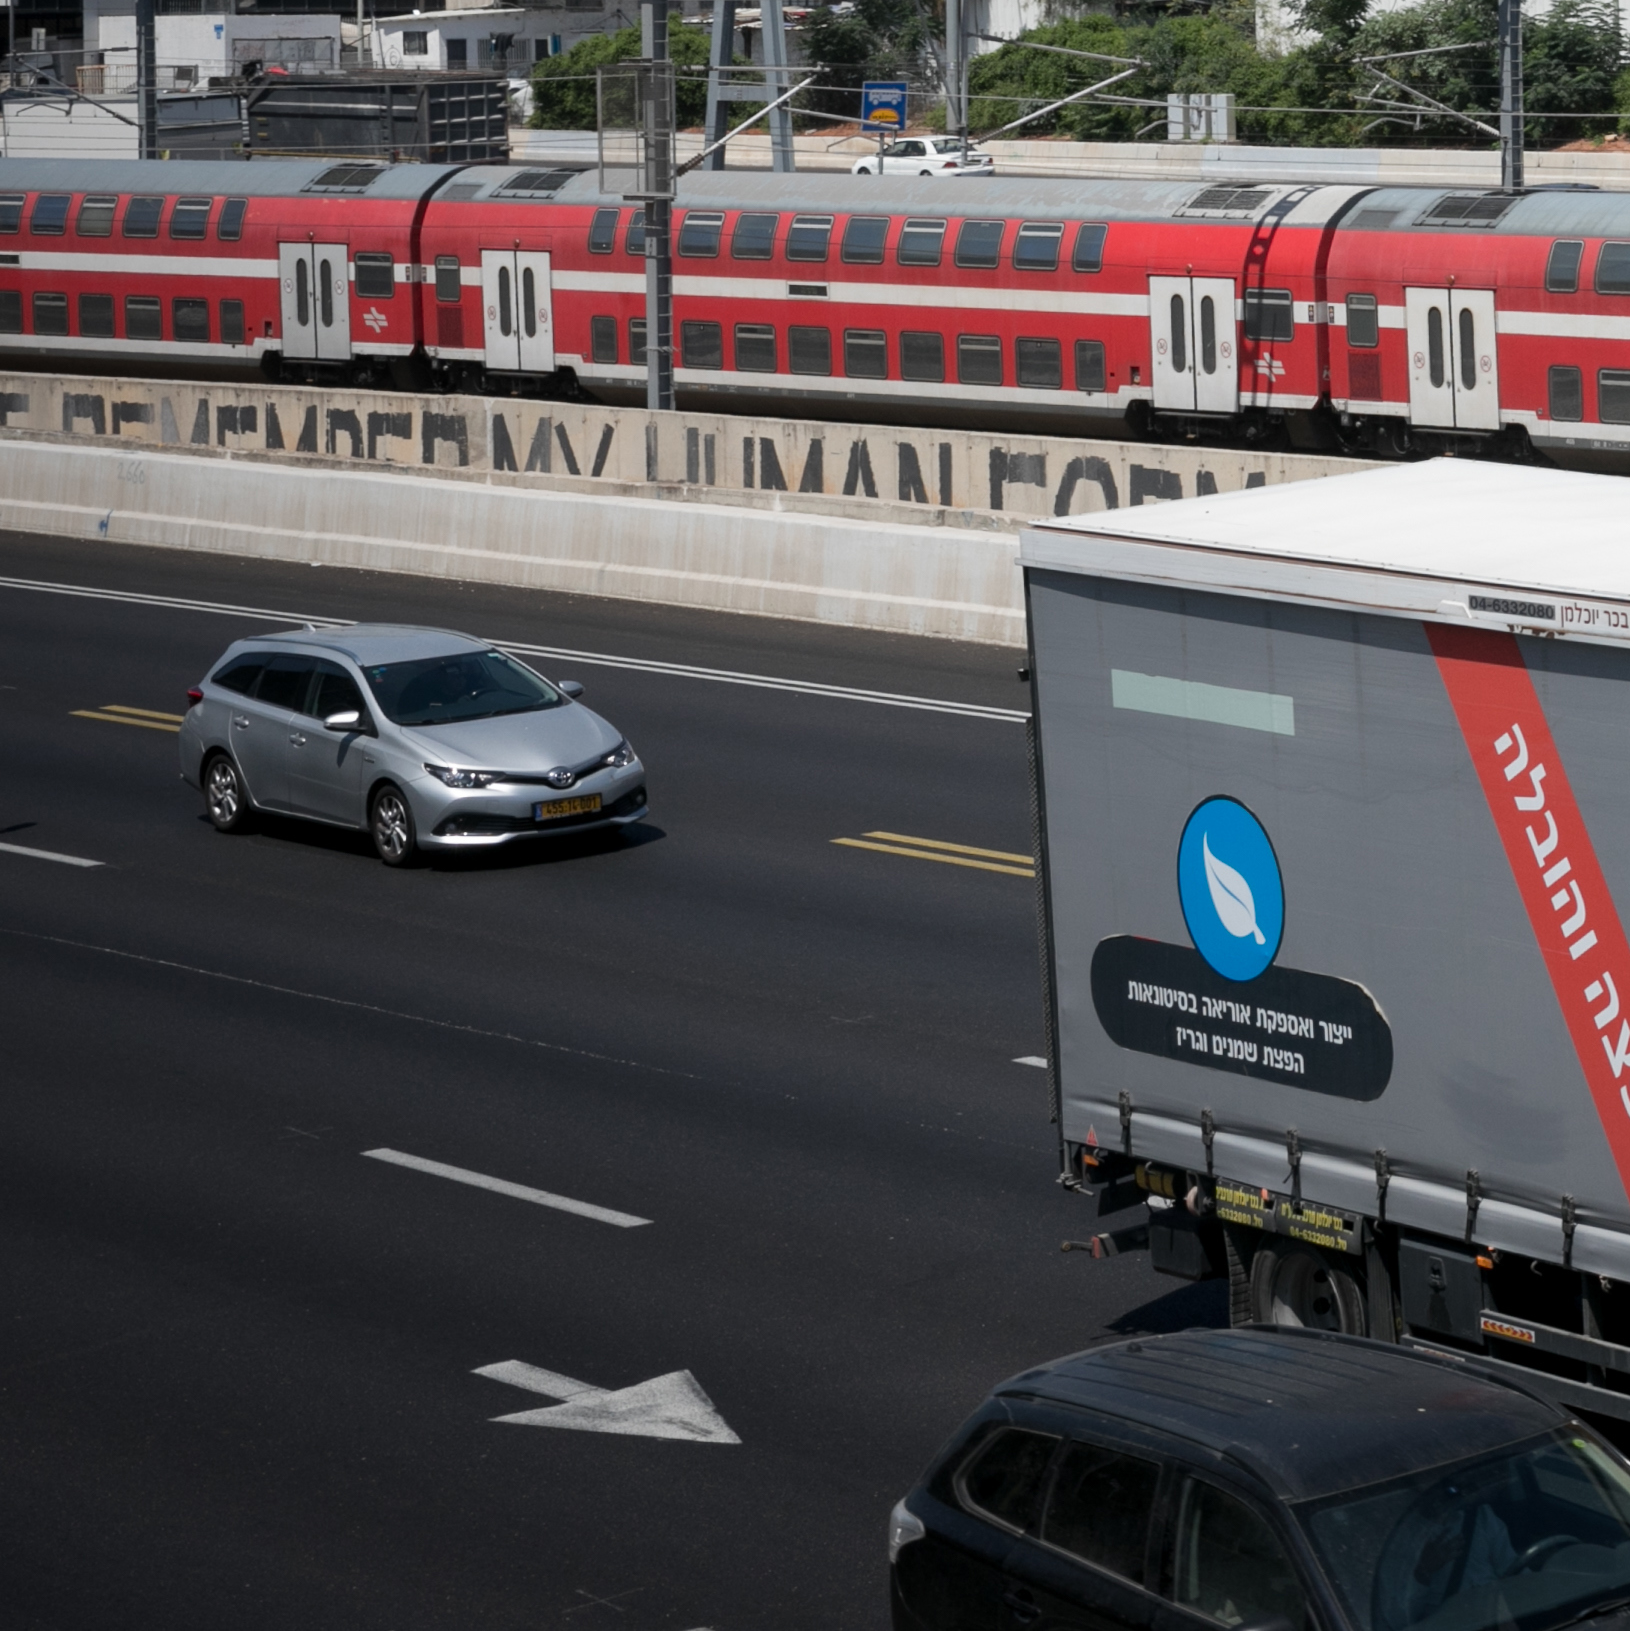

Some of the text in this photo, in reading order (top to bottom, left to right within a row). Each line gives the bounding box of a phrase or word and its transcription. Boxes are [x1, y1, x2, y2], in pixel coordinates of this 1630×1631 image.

[1469, 595, 1555, 620] 04-6332080
[1560, 602, 1599, 628] יוכלמן
[1604, 610, 1629, 630] בכר
[1494, 722, 1598, 961] והובלה
[1127, 980, 1353, 1045] ייצור ואספקת אוריאה בסיטונאות
[1176, 1026, 1305, 1074] הפצת שמנים וגריז
